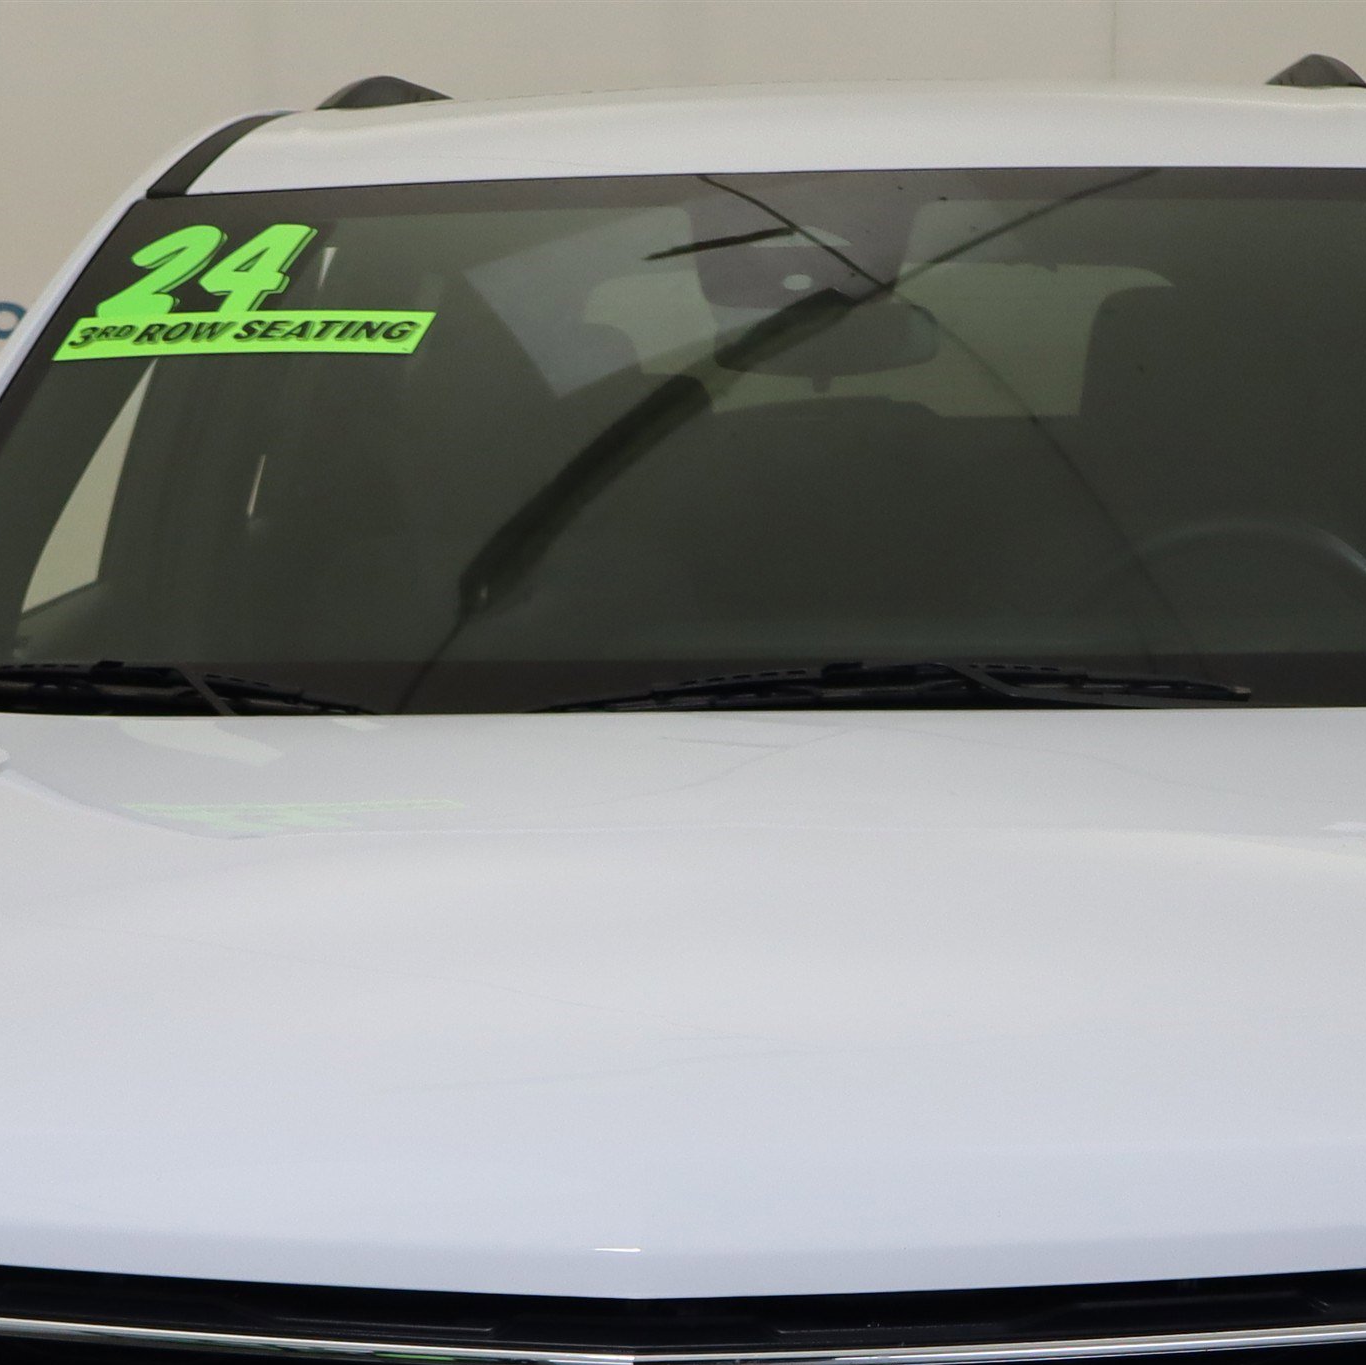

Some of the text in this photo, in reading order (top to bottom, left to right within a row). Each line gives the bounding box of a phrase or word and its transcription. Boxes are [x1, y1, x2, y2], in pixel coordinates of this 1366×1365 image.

[96, 223, 319, 318] 24
[68, 319, 422, 347] 3RD ROW SEATING
